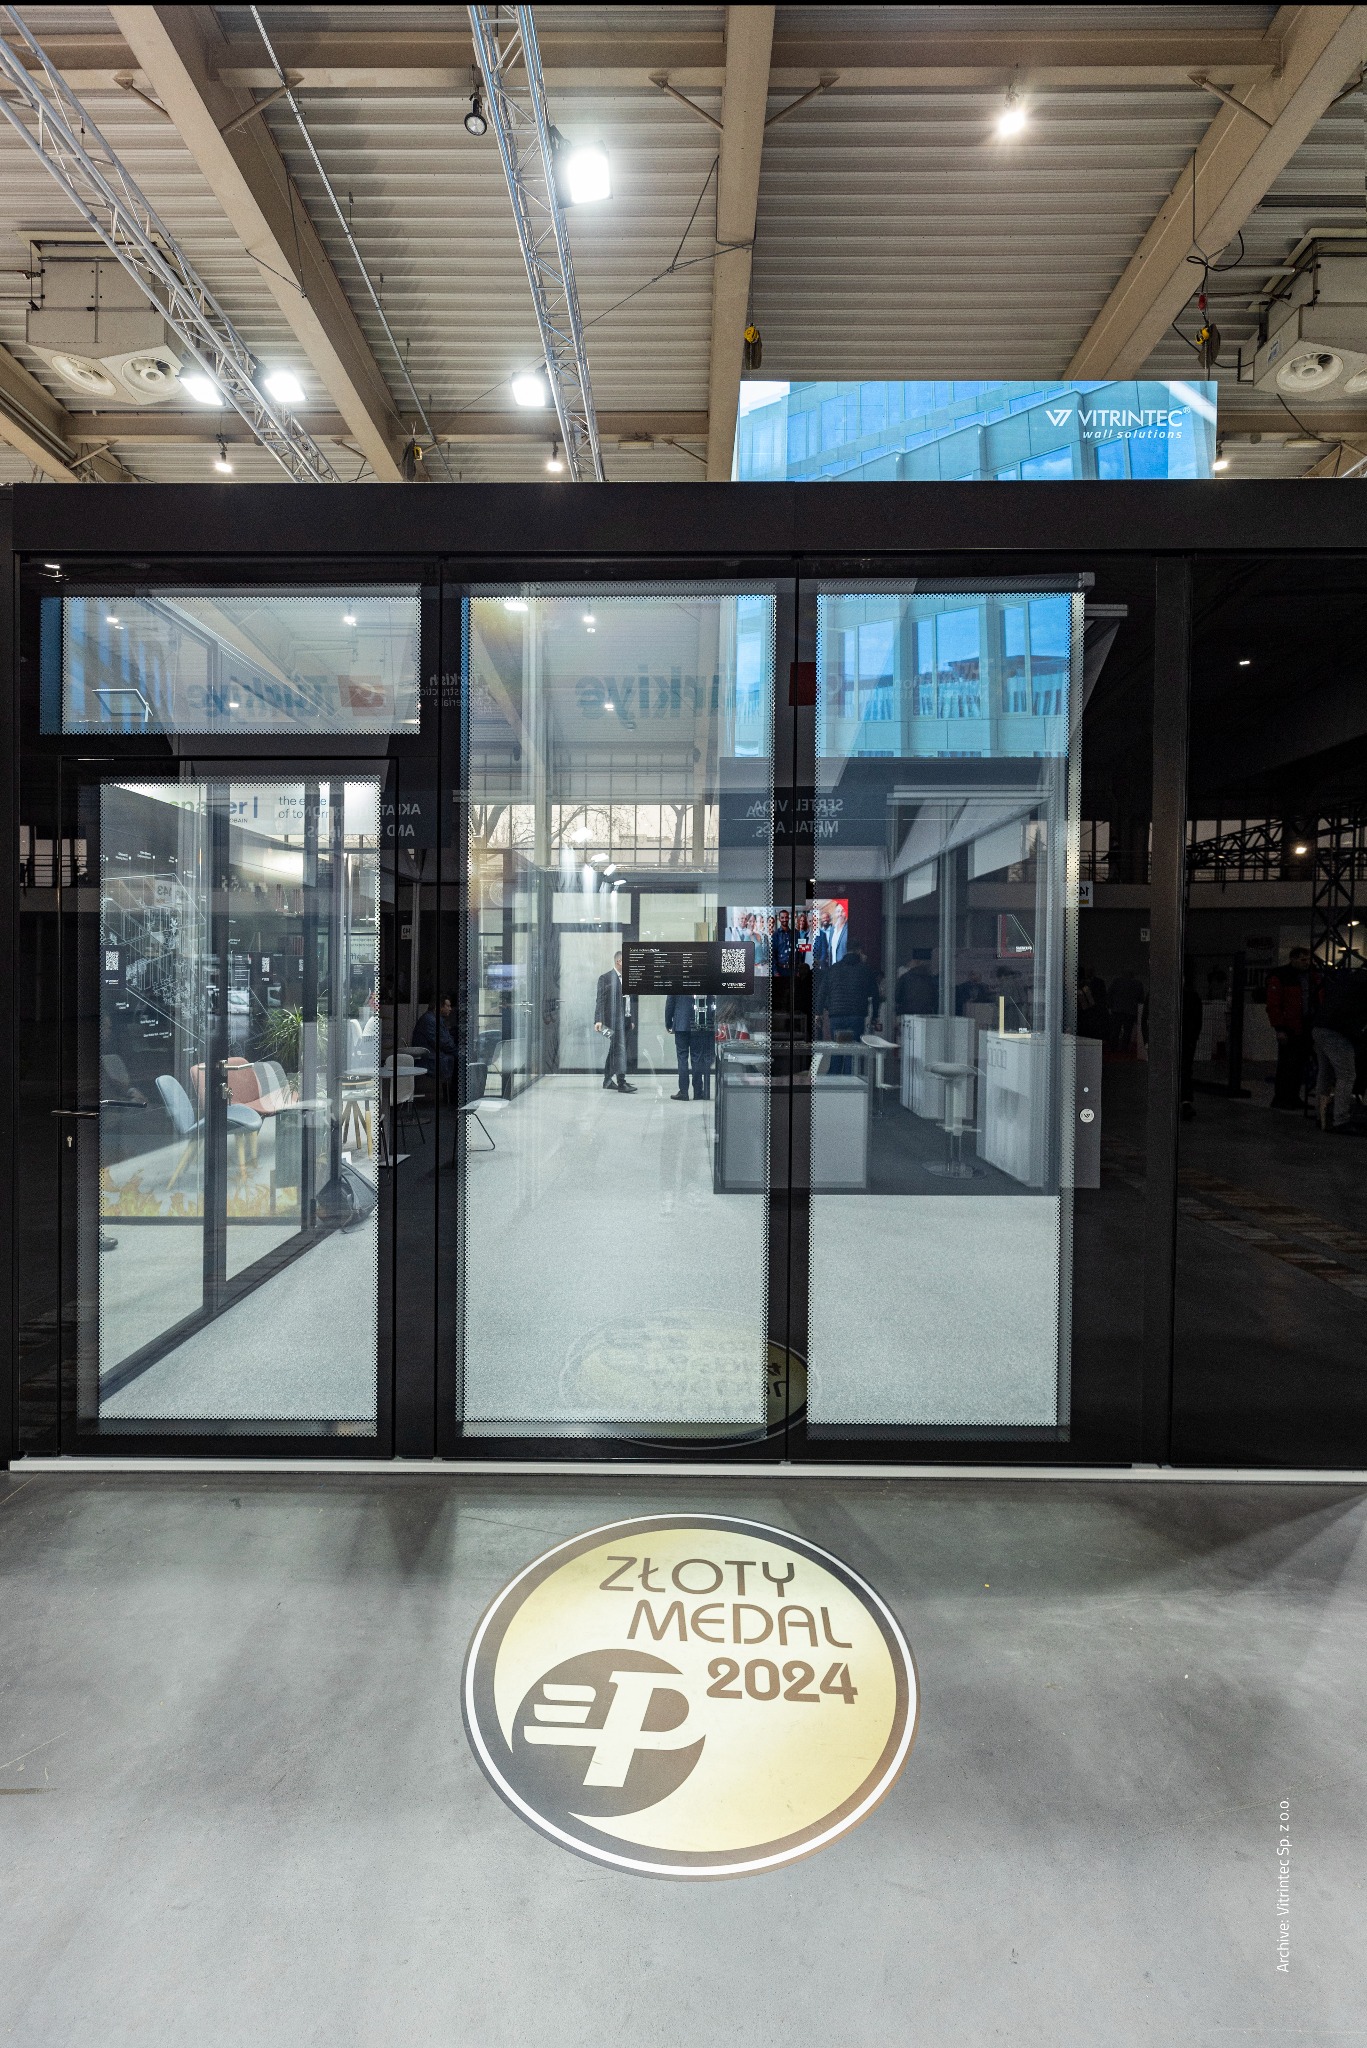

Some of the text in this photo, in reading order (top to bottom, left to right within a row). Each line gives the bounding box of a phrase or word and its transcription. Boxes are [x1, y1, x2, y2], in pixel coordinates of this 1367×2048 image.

[1083, 430, 1183, 439] wall solutions
[599, 1555, 796, 1598] ZŁOTY
[626, 1599, 853, 1649] MEDAL
[705, 1656, 859, 1705] 2024
